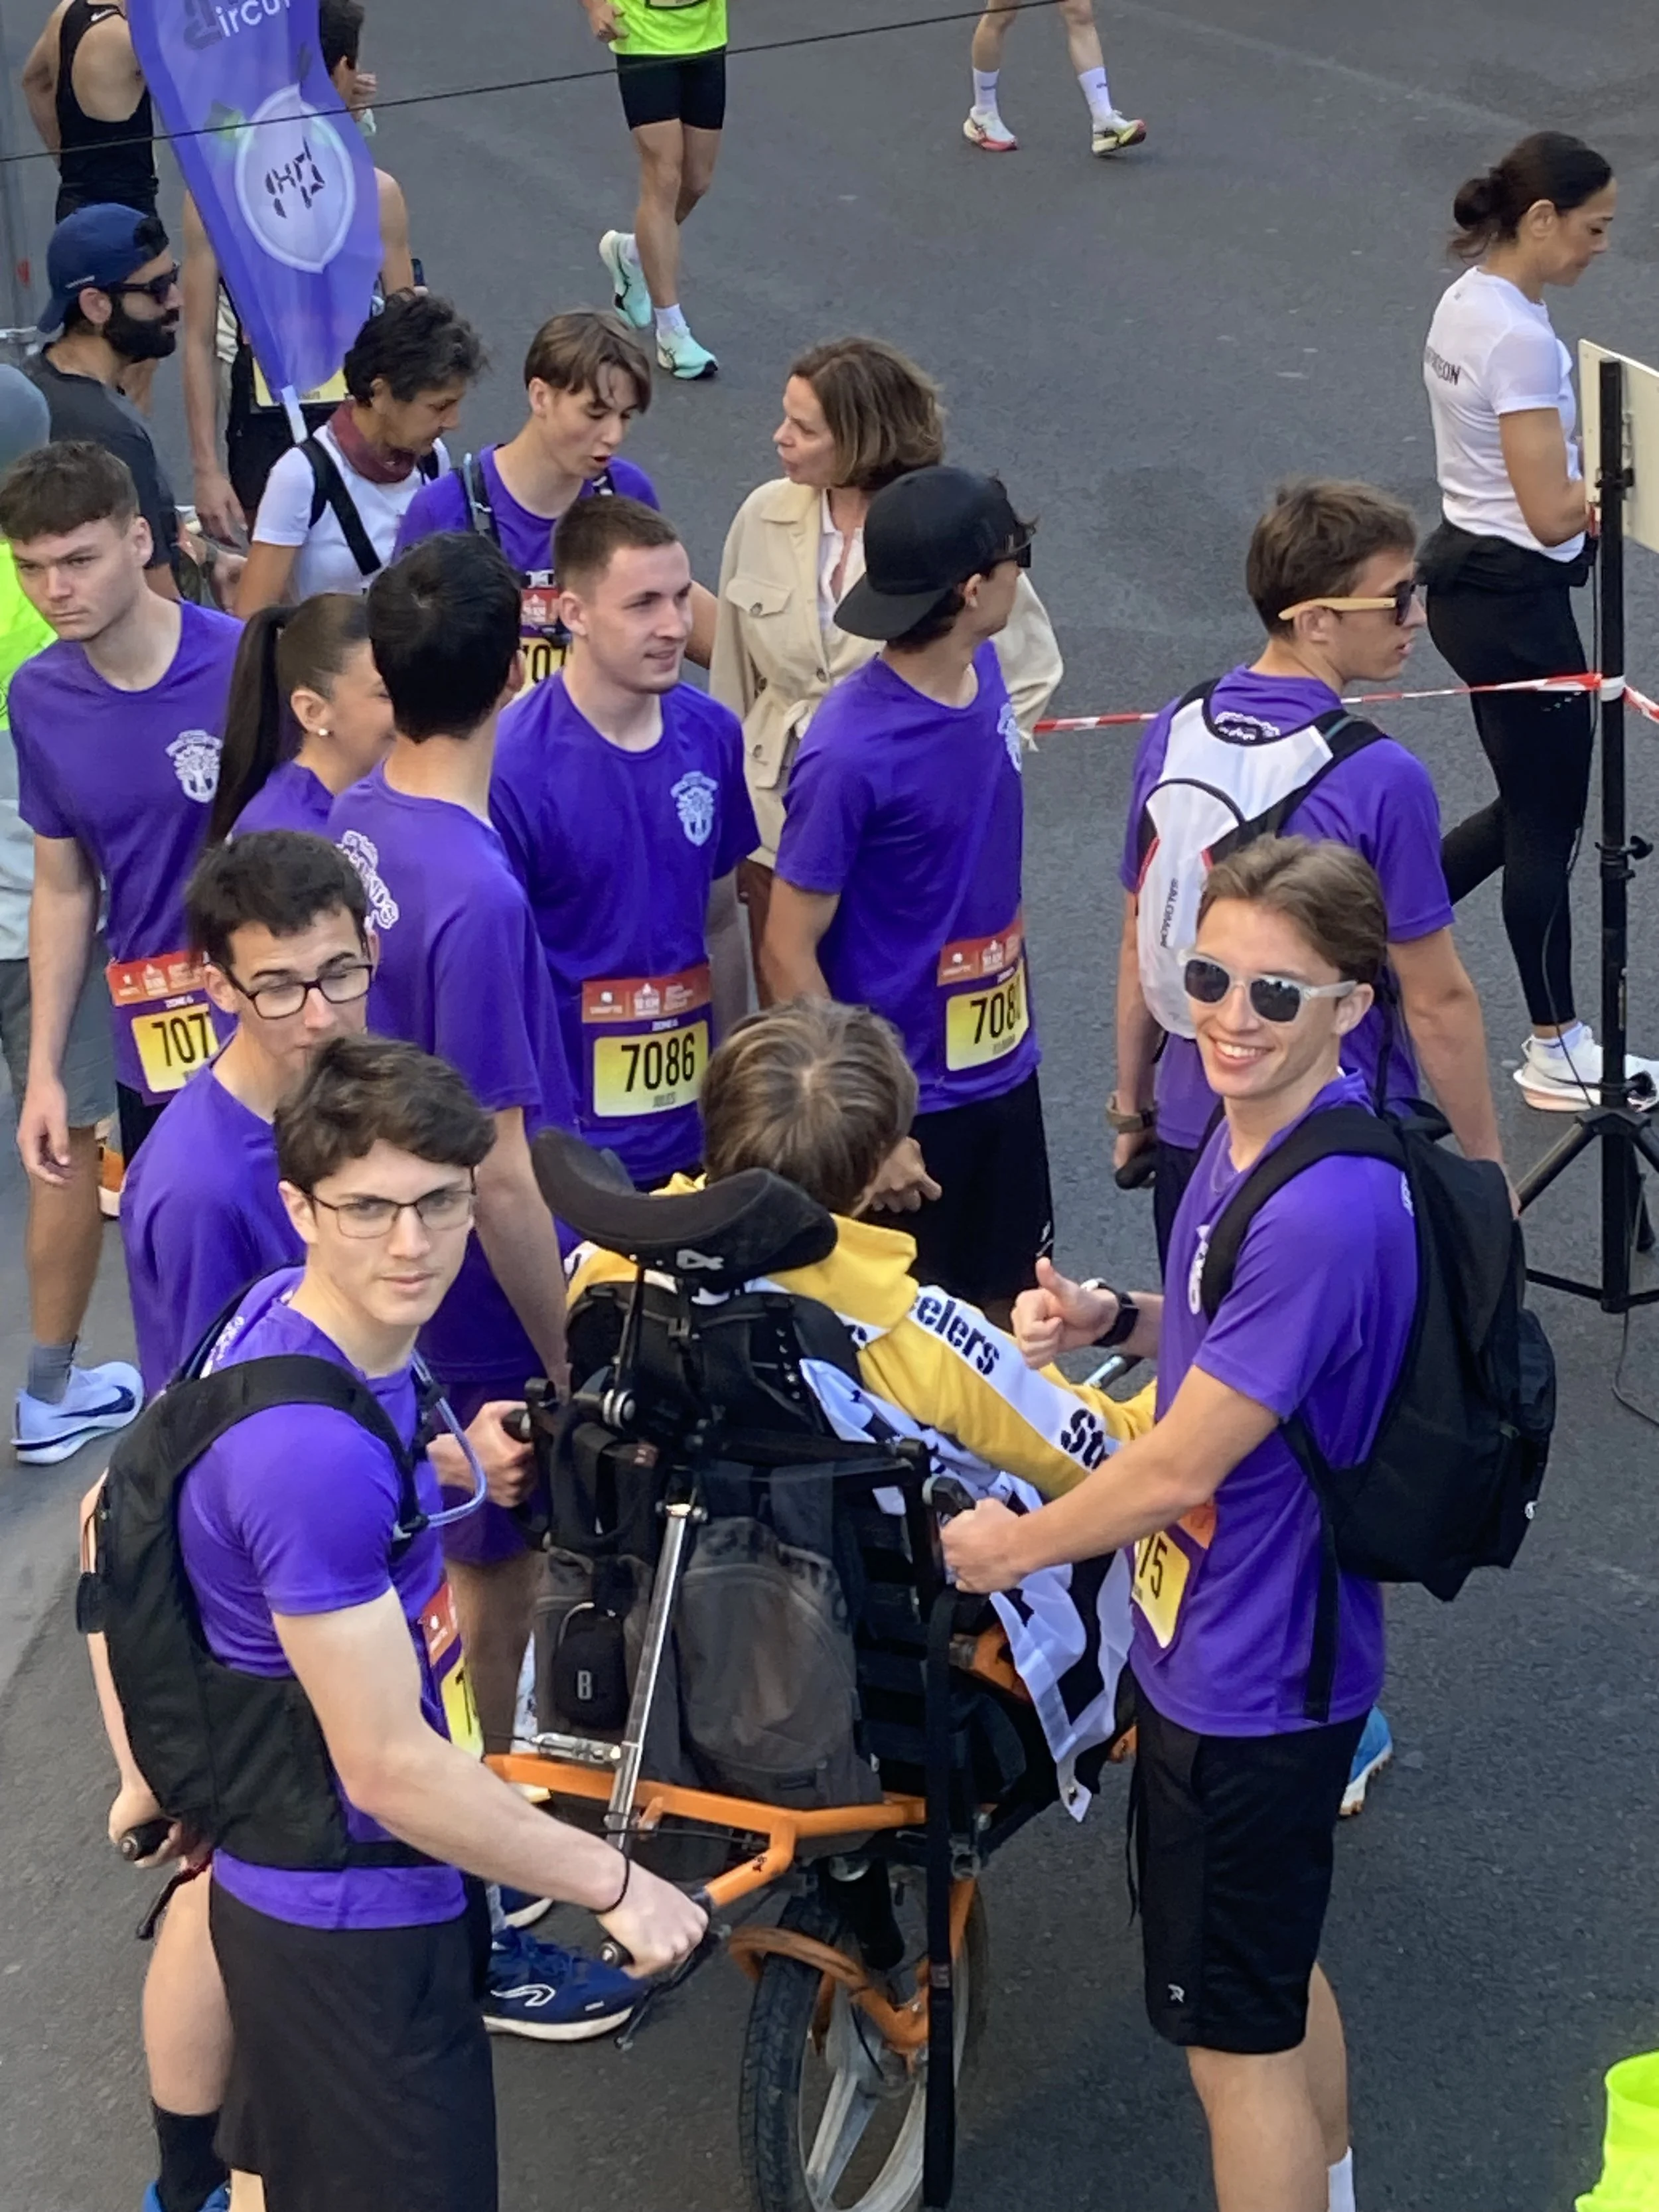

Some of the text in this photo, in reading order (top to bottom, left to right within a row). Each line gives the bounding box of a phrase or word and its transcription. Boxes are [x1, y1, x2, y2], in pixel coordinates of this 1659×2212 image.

[151, 1010, 210, 1067] 707
[621, 1032, 694, 1092] 7086
[909, 1296, 1000, 1375] elers
